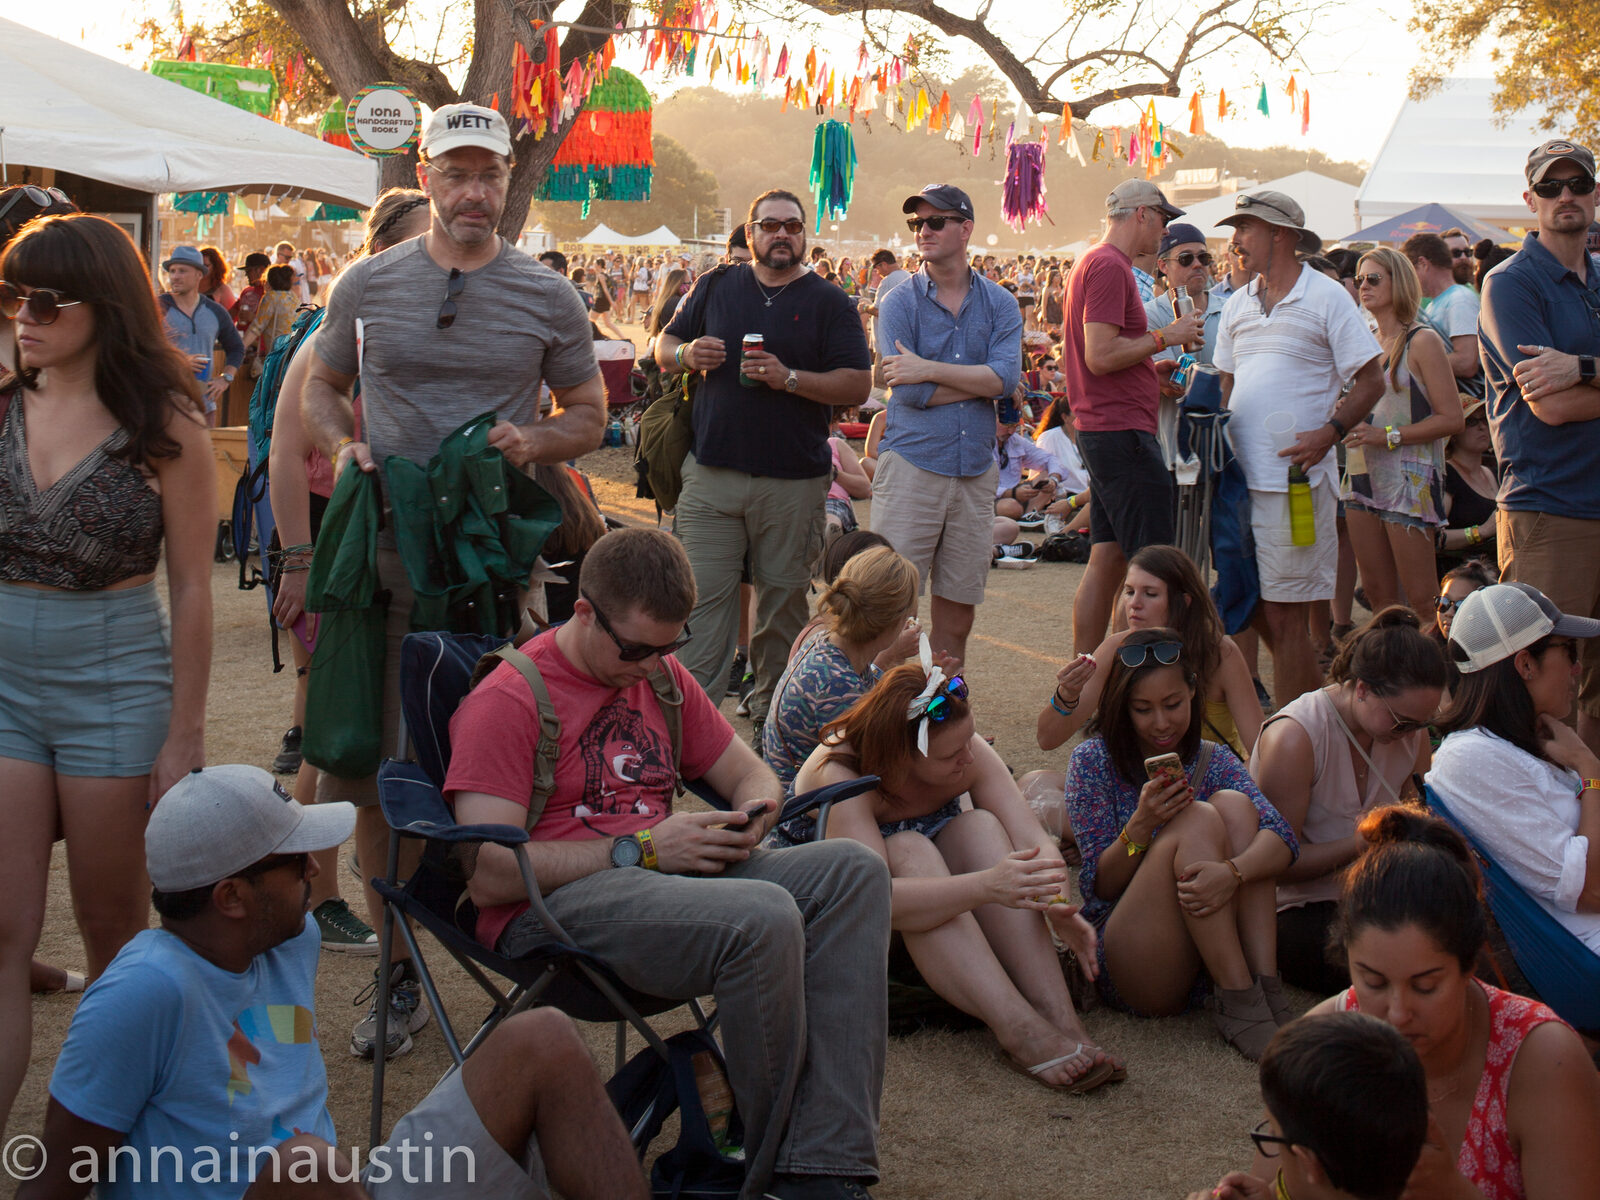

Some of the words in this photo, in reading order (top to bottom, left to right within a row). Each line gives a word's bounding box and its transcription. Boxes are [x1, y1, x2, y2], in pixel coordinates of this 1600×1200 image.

[357, 118, 414, 126] HANDCRAFTED
[371, 126, 399, 134] BOOKS
[563, 243, 584, 253] BAR
[628, 245, 650, 254] BAR
